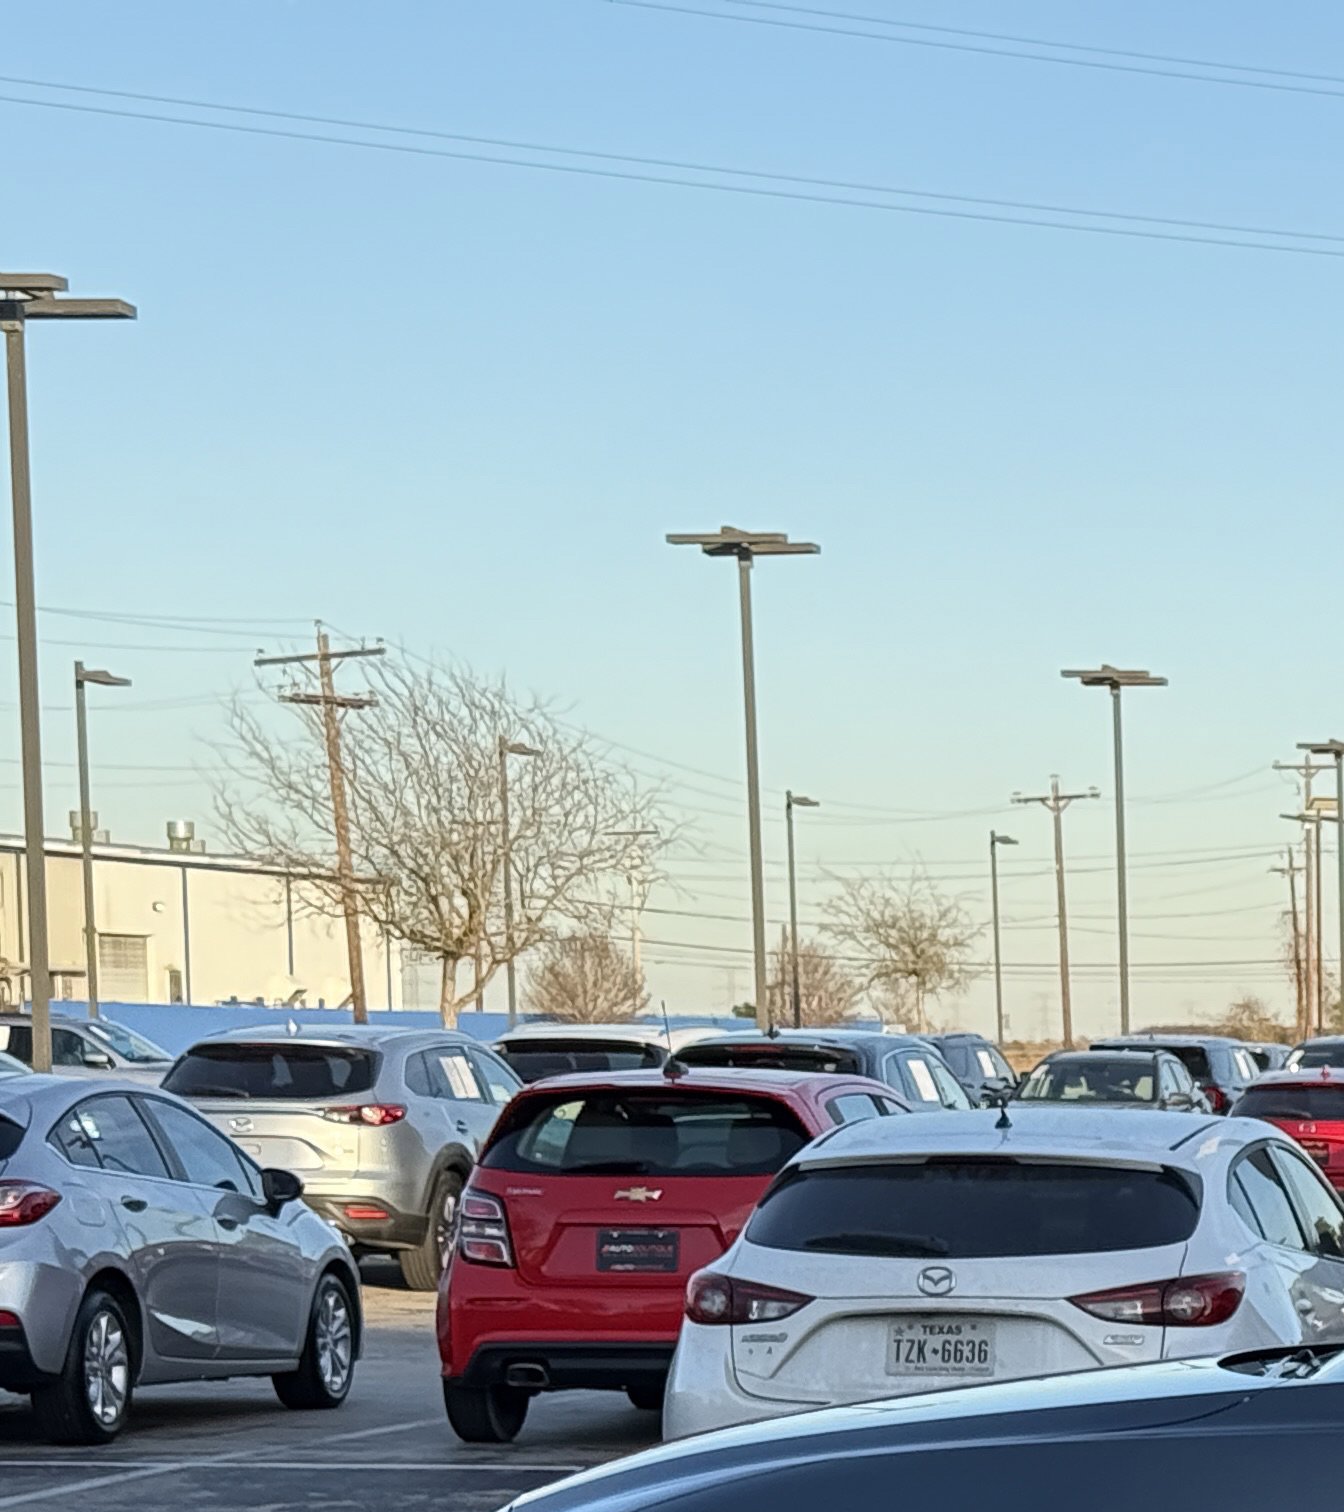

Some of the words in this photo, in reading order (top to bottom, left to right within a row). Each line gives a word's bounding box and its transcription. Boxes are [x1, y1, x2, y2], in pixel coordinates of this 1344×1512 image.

[921, 1324, 963, 1336] TEXAS
[893, 1338, 928, 1364] TZK
[941, 1339, 989, 1364] 6636
